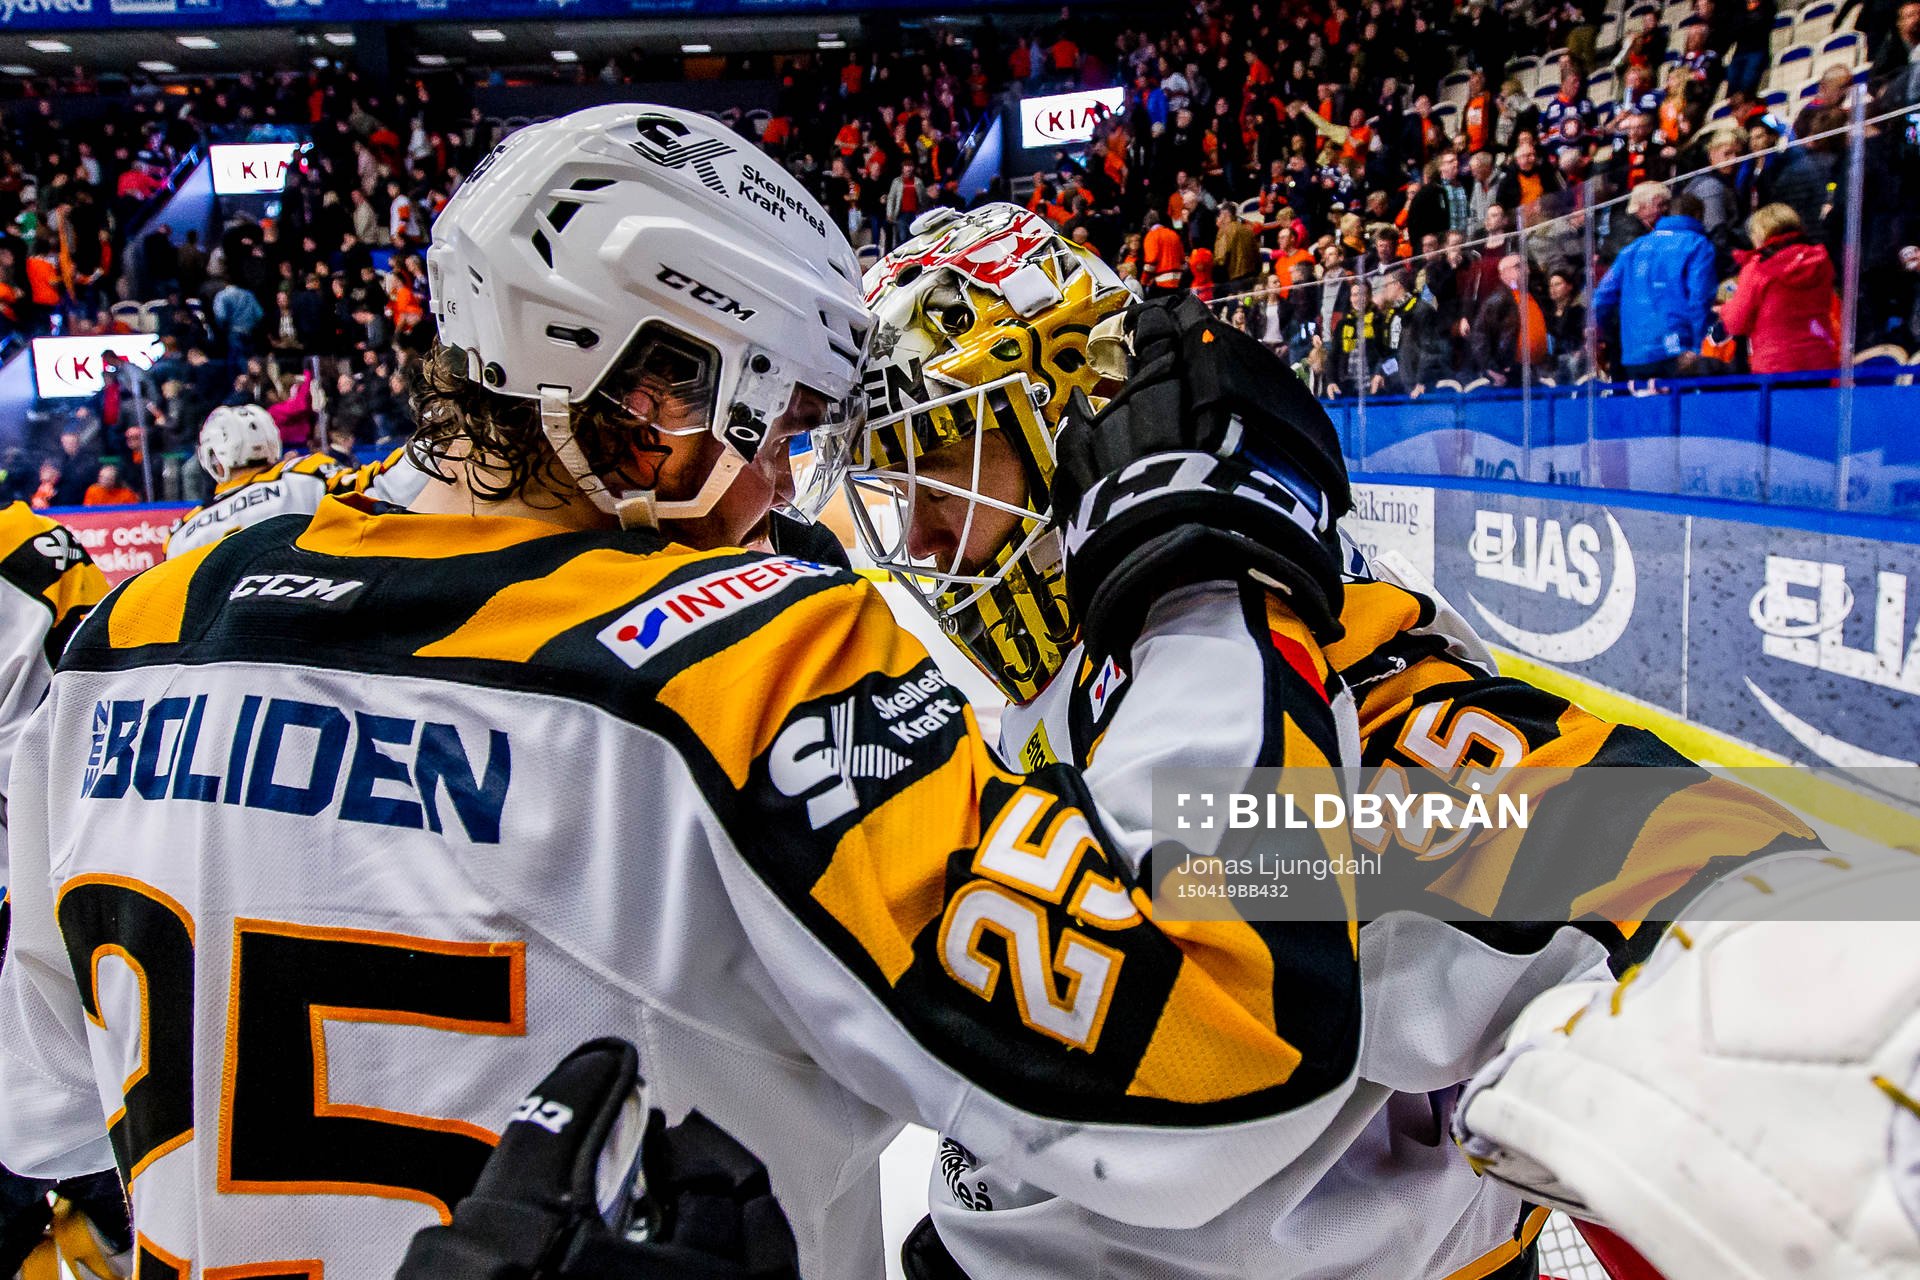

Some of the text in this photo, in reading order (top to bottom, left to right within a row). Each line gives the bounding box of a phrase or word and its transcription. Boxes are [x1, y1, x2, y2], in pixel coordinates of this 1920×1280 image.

[738, 181, 787, 222] Kraft
[741, 163, 826, 238] Skellefteå
[655, 262, 757, 322] CCM
[113, 520, 170, 547] ocks
[185, 484, 281, 538] BOLIDEN
[229, 574, 363, 601] CCM
[1468, 509, 1602, 606] ELIAS
[80, 700, 110, 799] NEW
[888, 699, 961, 745] Kraft
[89, 694, 511, 844] BOLIDEN
[936, 785, 1143, 1054] 25
[55, 872, 527, 1226] 25
